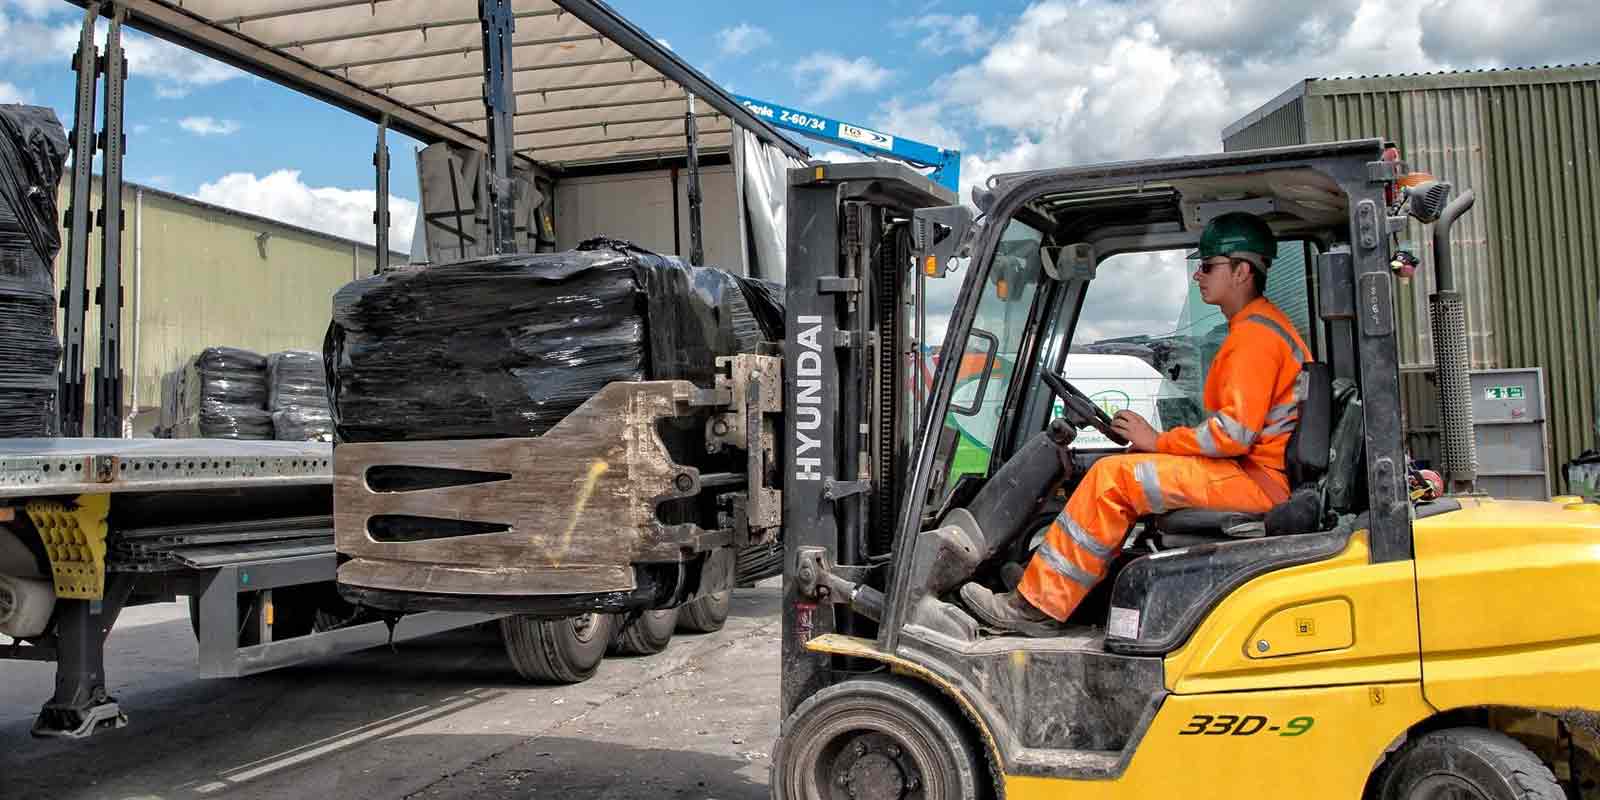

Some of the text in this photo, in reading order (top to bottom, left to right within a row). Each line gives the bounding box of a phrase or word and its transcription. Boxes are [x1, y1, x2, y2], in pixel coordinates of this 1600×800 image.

[780, 110, 826, 130] Z-60/34
[796, 315, 822, 480] HYUNDAI
[1178, 715, 1315, 736] 33D-9
